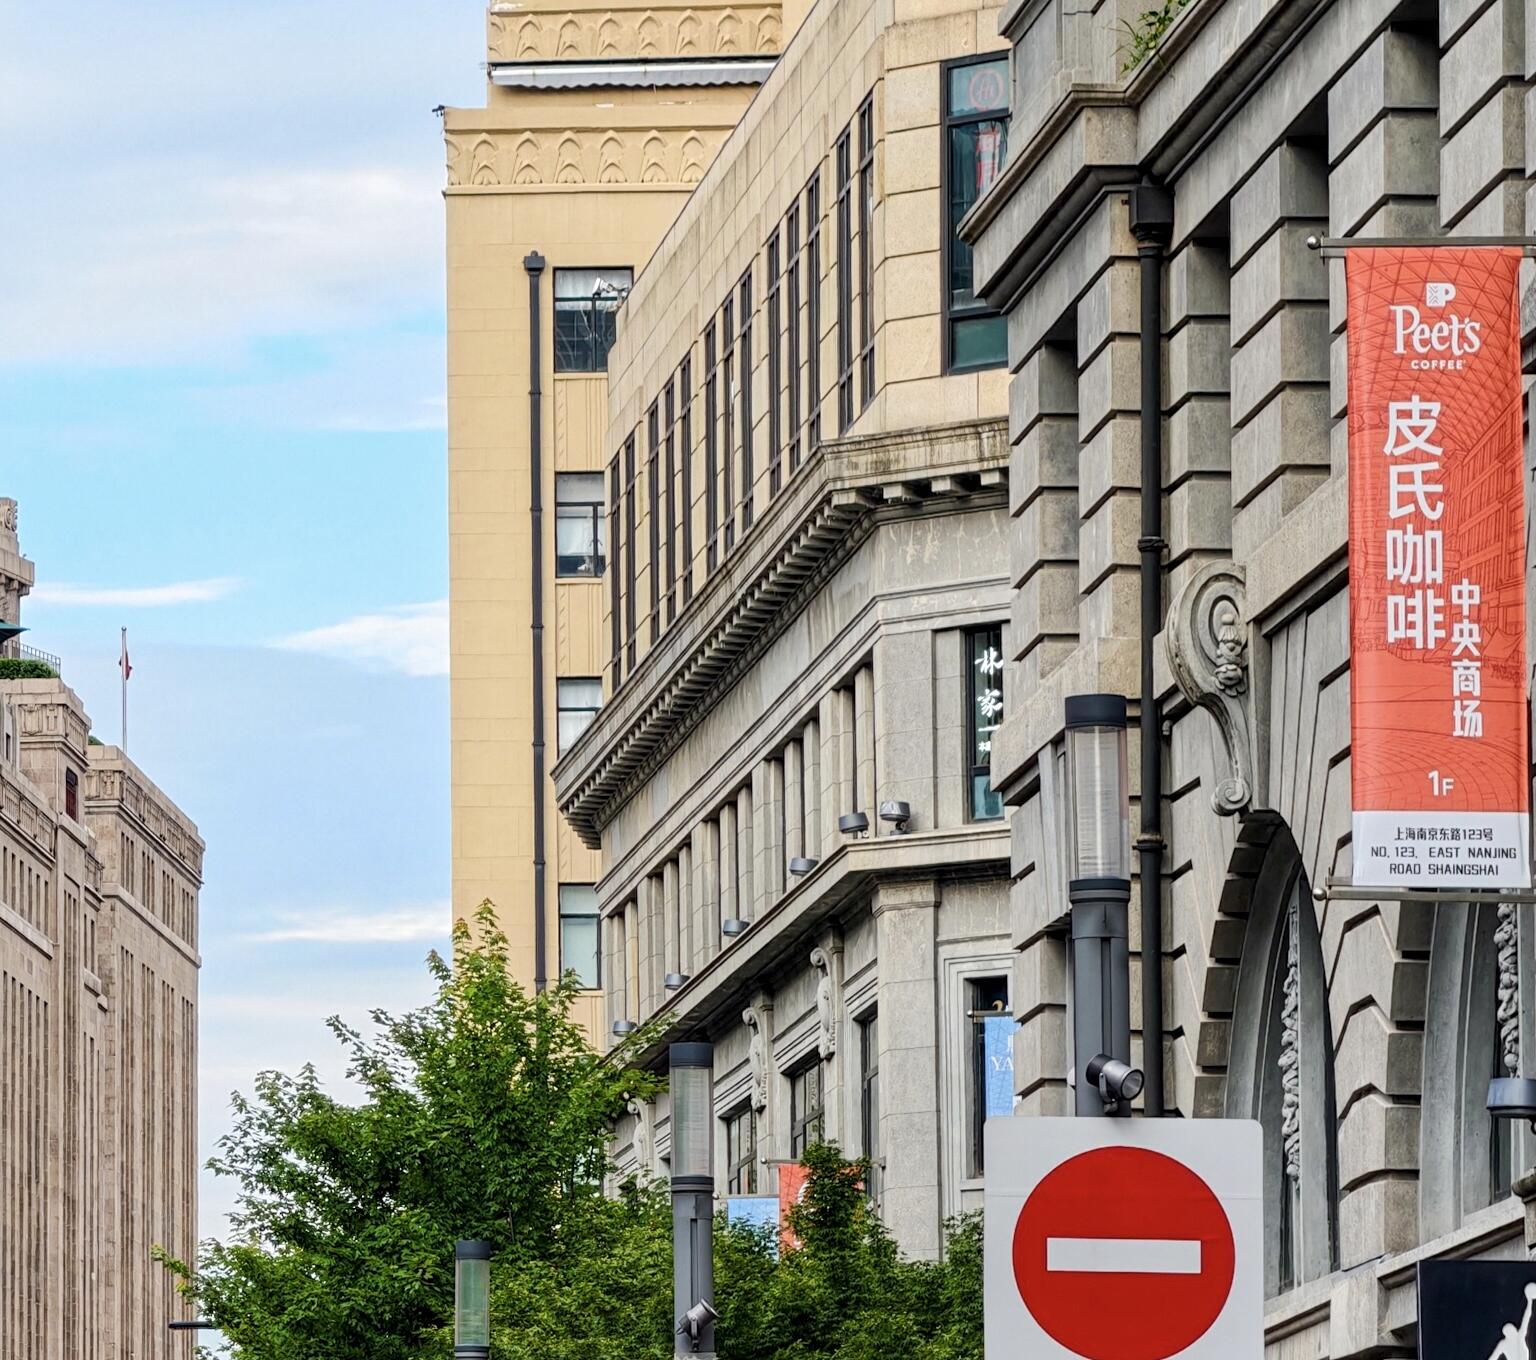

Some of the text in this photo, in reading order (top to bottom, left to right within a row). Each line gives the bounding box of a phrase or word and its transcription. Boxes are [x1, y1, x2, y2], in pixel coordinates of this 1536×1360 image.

[1389, 305, 1481, 356] Peet's
[1410, 359, 1464, 370] COFFEE
[1383, 395, 1445, 650] 皮氏咖啡
[1451, 578, 1483, 738] 中央商场
[1428, 769, 1455, 797] 1F
[1394, 826, 1494, 842] 上海南京东路123号
[1428, 846, 1461, 859] EAST
[1467, 846, 1517, 860] NANJING
[1389, 863, 1499, 876] ROAD SHAINGSHAI
